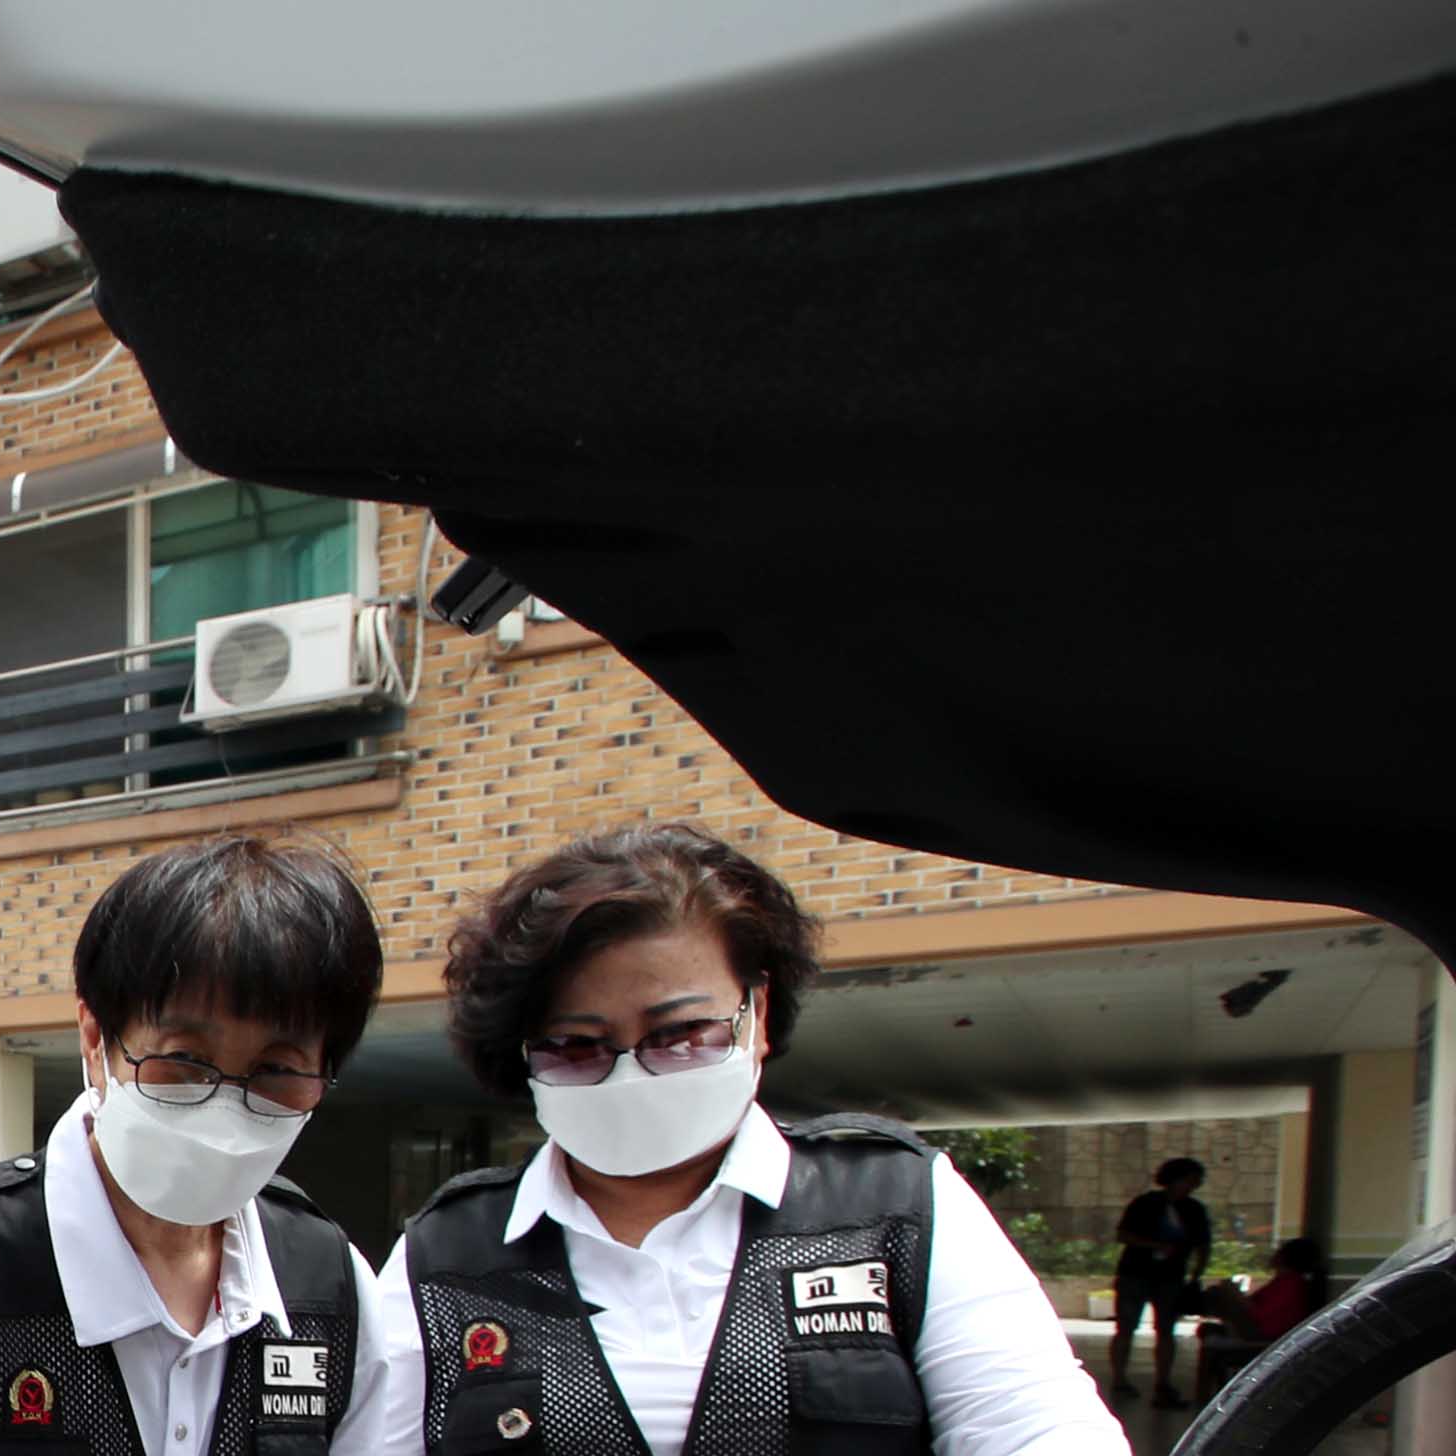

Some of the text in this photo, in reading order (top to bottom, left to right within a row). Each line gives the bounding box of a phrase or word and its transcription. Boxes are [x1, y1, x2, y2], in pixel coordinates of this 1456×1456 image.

[794, 1311, 893, 1336] WOMAN DRI
[261, 1393, 308, 1415] WOMAN
